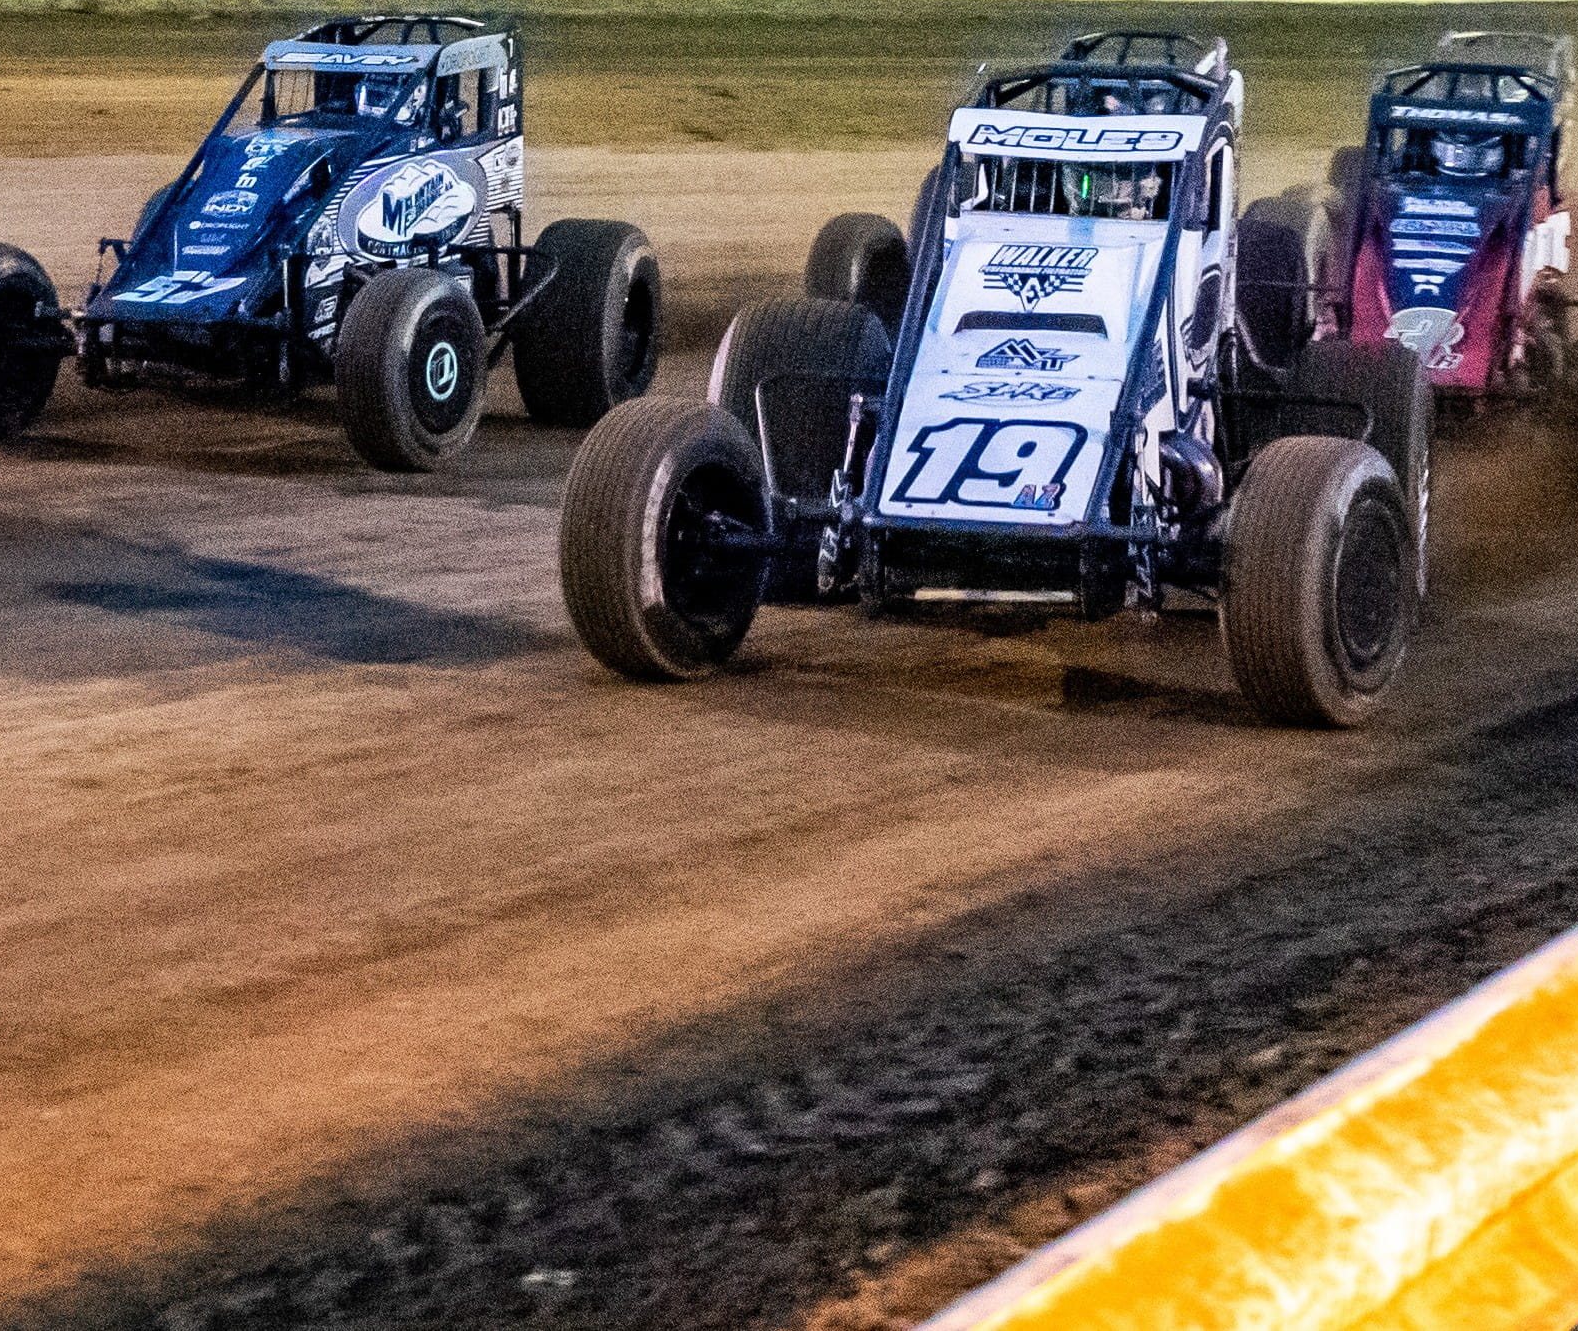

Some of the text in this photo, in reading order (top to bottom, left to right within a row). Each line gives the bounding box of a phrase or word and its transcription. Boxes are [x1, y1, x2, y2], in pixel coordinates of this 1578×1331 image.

[275, 52, 418, 66] SEAVEY
[1389, 106, 1508, 122] THOMAS
[202, 203, 252, 212] INDY
[989, 244, 1099, 267] WALKER
[889, 417, 1088, 507] 19
